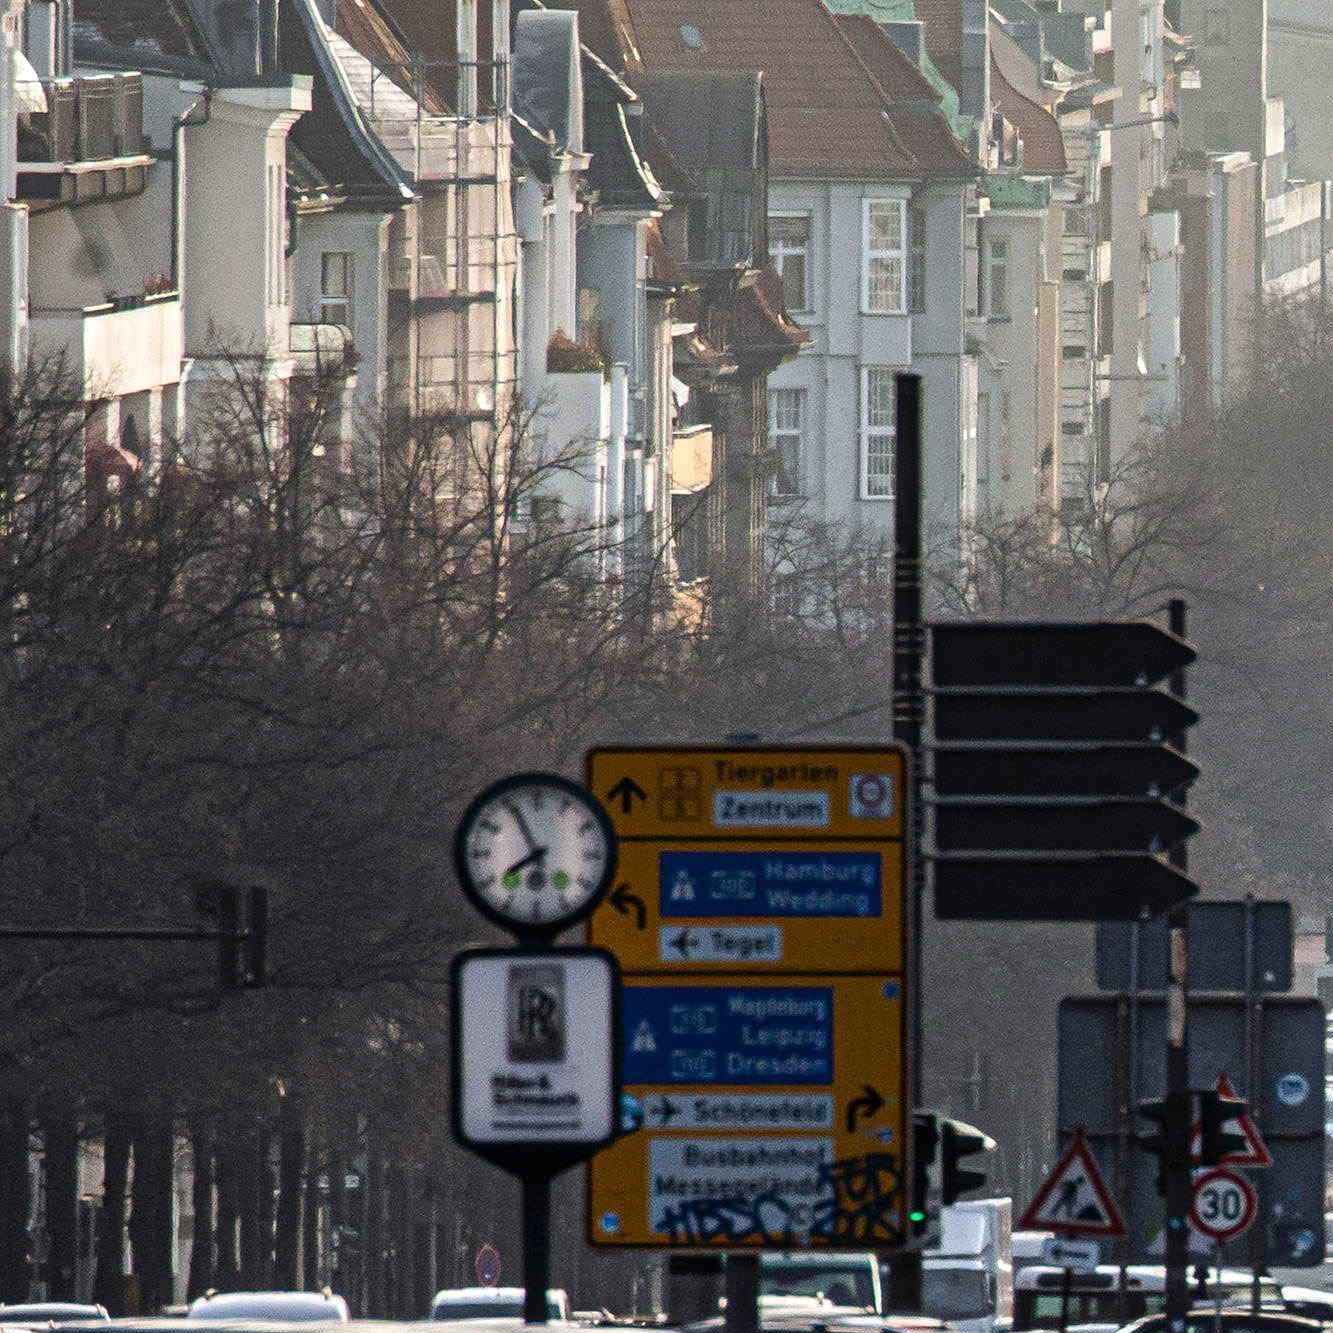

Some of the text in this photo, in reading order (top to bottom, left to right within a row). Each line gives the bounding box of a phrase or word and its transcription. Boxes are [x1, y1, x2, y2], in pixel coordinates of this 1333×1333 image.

[714, 760, 839, 787] Tiergarten
[722, 796, 824, 820] Zentrum
[764, 860, 876, 886] Hamburg
[766, 890, 870, 915] Wedding
[710, 930, 776, 959] Tegel
[727, 995, 827, 1021] Magdeburg
[741, 1025, 827, 1049] Leipzig
[727, 1052, 827, 1075] Dresden
[694, 1098, 827, 1123] Schönefeld
[683, 1144, 826, 1167] Busbahnhof
[1203, 1188, 1241, 1221] 30
